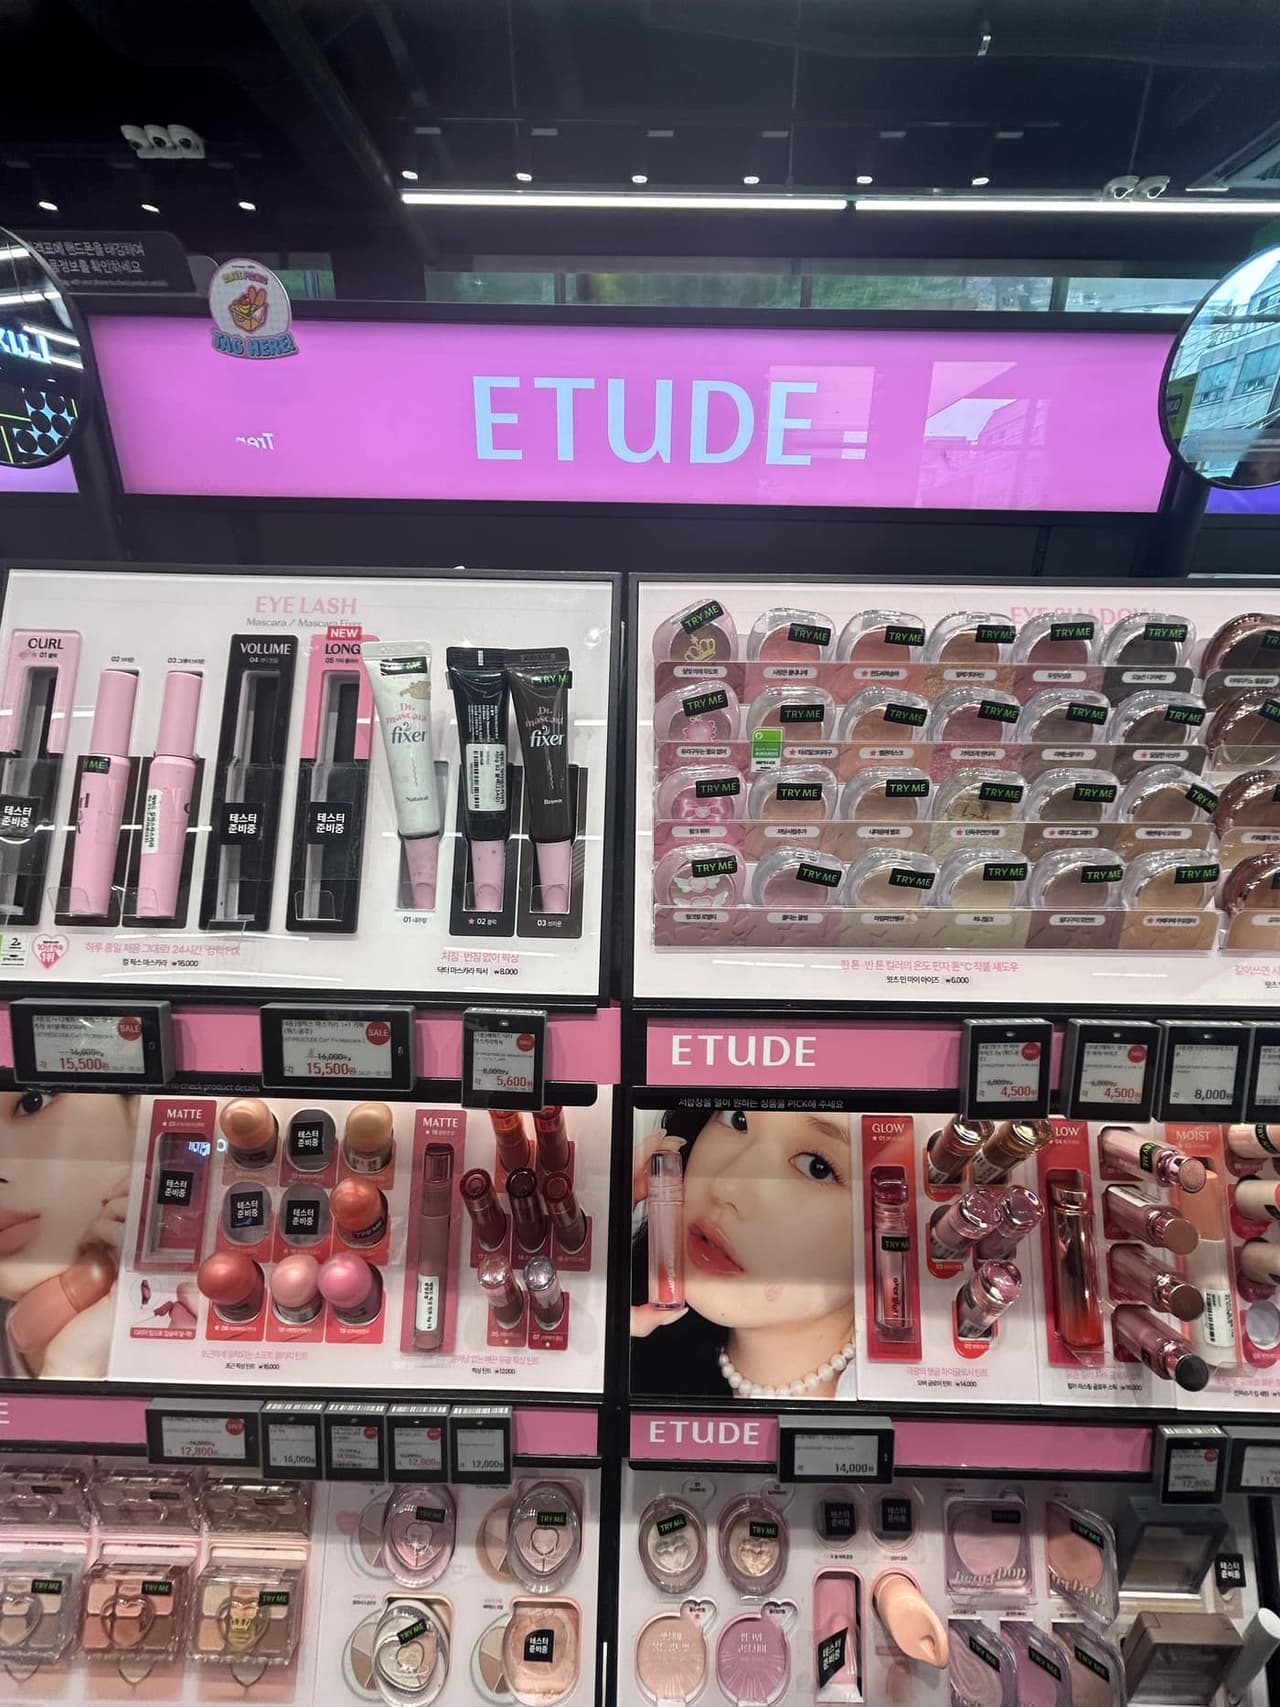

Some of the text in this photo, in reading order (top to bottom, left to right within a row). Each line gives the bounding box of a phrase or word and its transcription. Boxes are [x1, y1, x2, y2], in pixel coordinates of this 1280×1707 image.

[214, 331, 244, 354] TAG
[473, 376, 818, 466] ETUDE
[256, 596, 356, 615] EYE LASH
[246, 617, 339, 628] Mascara Mascara
[686, 605, 720, 629] TRY ME
[331, 628, 359, 639] NEW
[793, 628, 829, 642] TRY ME
[890, 632, 923, 643] TRY ME
[981, 629, 1015, 640] TRY ME
[1055, 627, 1091, 638] TRY ME
[1150, 628, 1185, 639] TRY ME
[27, 638, 64, 650] CURL
[240, 643, 292, 655] VOLUME
[325, 643, 361, 655] LONG
[400, 703, 415, 711] Dr.
[687, 695, 724, 712] TRY ME
[386, 711, 427, 723] mascara
[785, 709, 822, 720] TRY ME
[891, 709, 924, 722] TRY ME
[984, 705, 1017, 720] TRY ME
[1072, 707, 1106, 721] TRY ME
[392, 722, 426, 744] fixer
[530, 725, 565, 748] fixer
[701, 782, 737, 794] TRY ME
[781, 788, 818, 798] TRY ME
[889, 783, 926, 794] TRY ME
[984, 787, 1020, 800] TRY ME
[1078, 788, 1114, 799] TRY ME
[1192, 790, 1207, 804] TRY
[4, 805, 32, 817] 테스터
[2, 816, 31, 828] 준비중
[229, 813, 257, 823] 테스터
[317, 812, 345, 823] 테스터
[228, 823, 257, 834] 준비중
[316, 823, 345, 834] 준비중
[696, 860, 736, 874] TRY ME
[988, 867, 1025, 878] TRY ME
[802, 868, 838, 884] TRY ME
[1087, 869, 1122, 880] TRY ME
[1180, 868, 1217, 880] TRY ME
[895, 874, 932, 888] TRY ME
[403, 916, 412, 924] 01
[477, 917, 486, 925] 02
[537, 919, 547, 927] 03
[120, 1025, 139, 1033] SALE
[672, 1034, 817, 1067] ETUDE
[203, 1085, 233, 1093] product
[818, 1100, 844, 1109] 주세요
[167, 1109, 202, 1119] MATTE
[423, 1117, 459, 1128] MATTE
[872, 1123, 904, 1133] GLOW
[298, 1130, 319, 1139] 테스터
[1176, 1130, 1211, 1141] MOIST
[297, 1139, 319, 1148] 준비중
[167, 1179, 187, 1189] 테스터
[165, 1188, 186, 1199] 준비중
[237, 1200, 258, 1210] 테스터
[237, 1209, 258, 1219] 준비중
[293, 1208, 314, 1217] 테스터
[293, 1217, 314, 1226] 준비중
[650, 1420, 760, 1445] ETUDE
[1220, 1562, 1239, 1570] 테스터
[1220, 1570, 1240, 1580] 준비중
[530, 1637, 548, 1645] 테스터
[529, 1644, 548, 1654] 준비중
